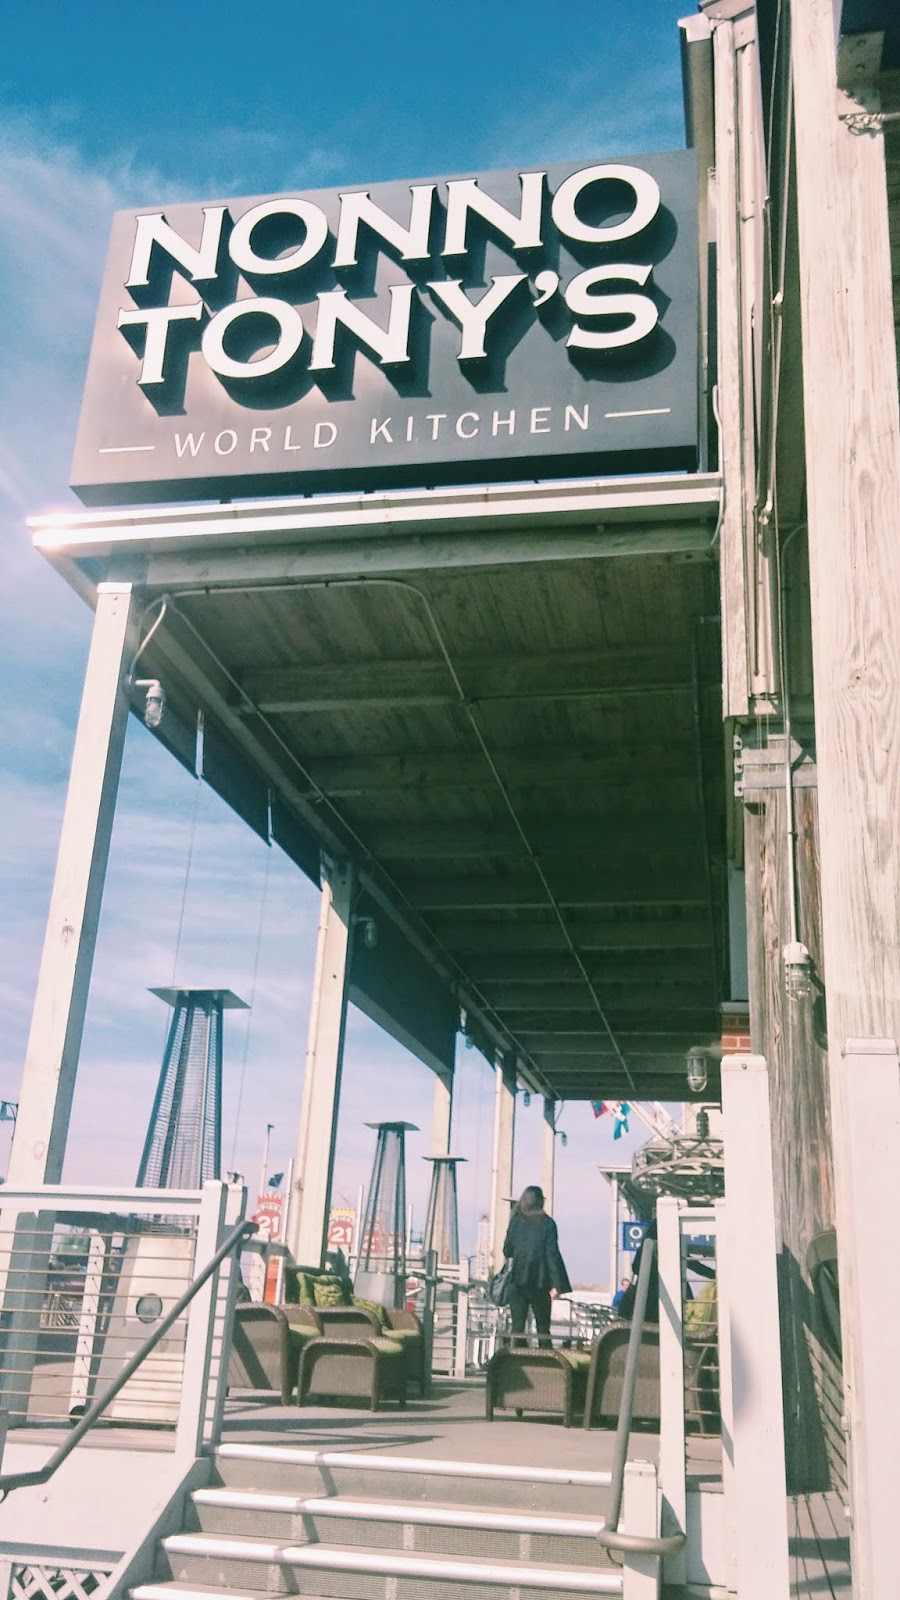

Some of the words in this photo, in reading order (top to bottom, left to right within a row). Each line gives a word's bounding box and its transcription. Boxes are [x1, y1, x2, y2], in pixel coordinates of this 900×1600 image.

[124, 163, 661, 287] NONNO
[117, 263, 659, 386] TONY'S
[174, 422, 338, 458] WORLD
[370, 404, 591, 444] KITCHEN
[258, 1215, 280, 1233] 21
[331, 1226, 353, 1243] 21
